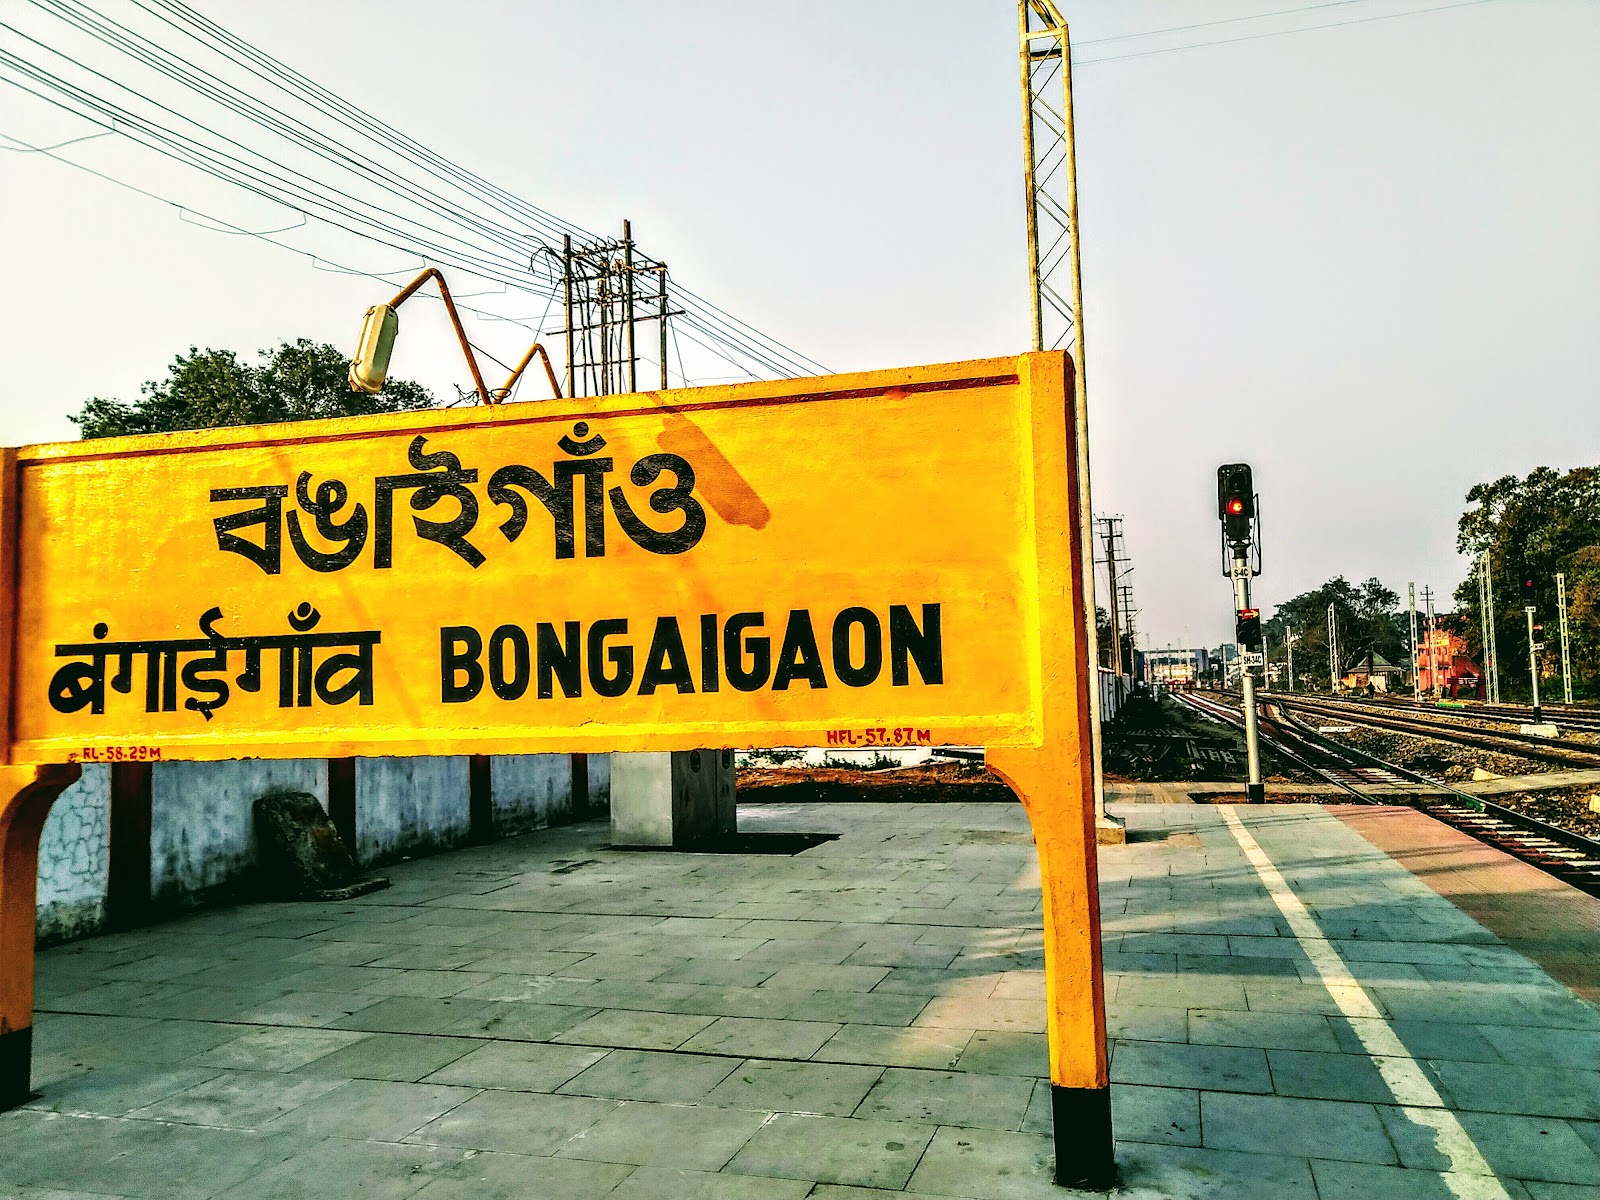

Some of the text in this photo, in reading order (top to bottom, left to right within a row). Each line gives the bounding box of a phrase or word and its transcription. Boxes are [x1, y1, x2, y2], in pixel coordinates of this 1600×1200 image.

[210, 421, 706, 574] বঙাইগাঁও
[1233, 568, 1249, 578] S-4C
[49, 602, 381, 721] बंगाईगाँव
[441, 603, 943, 702] BONGAIGAON
